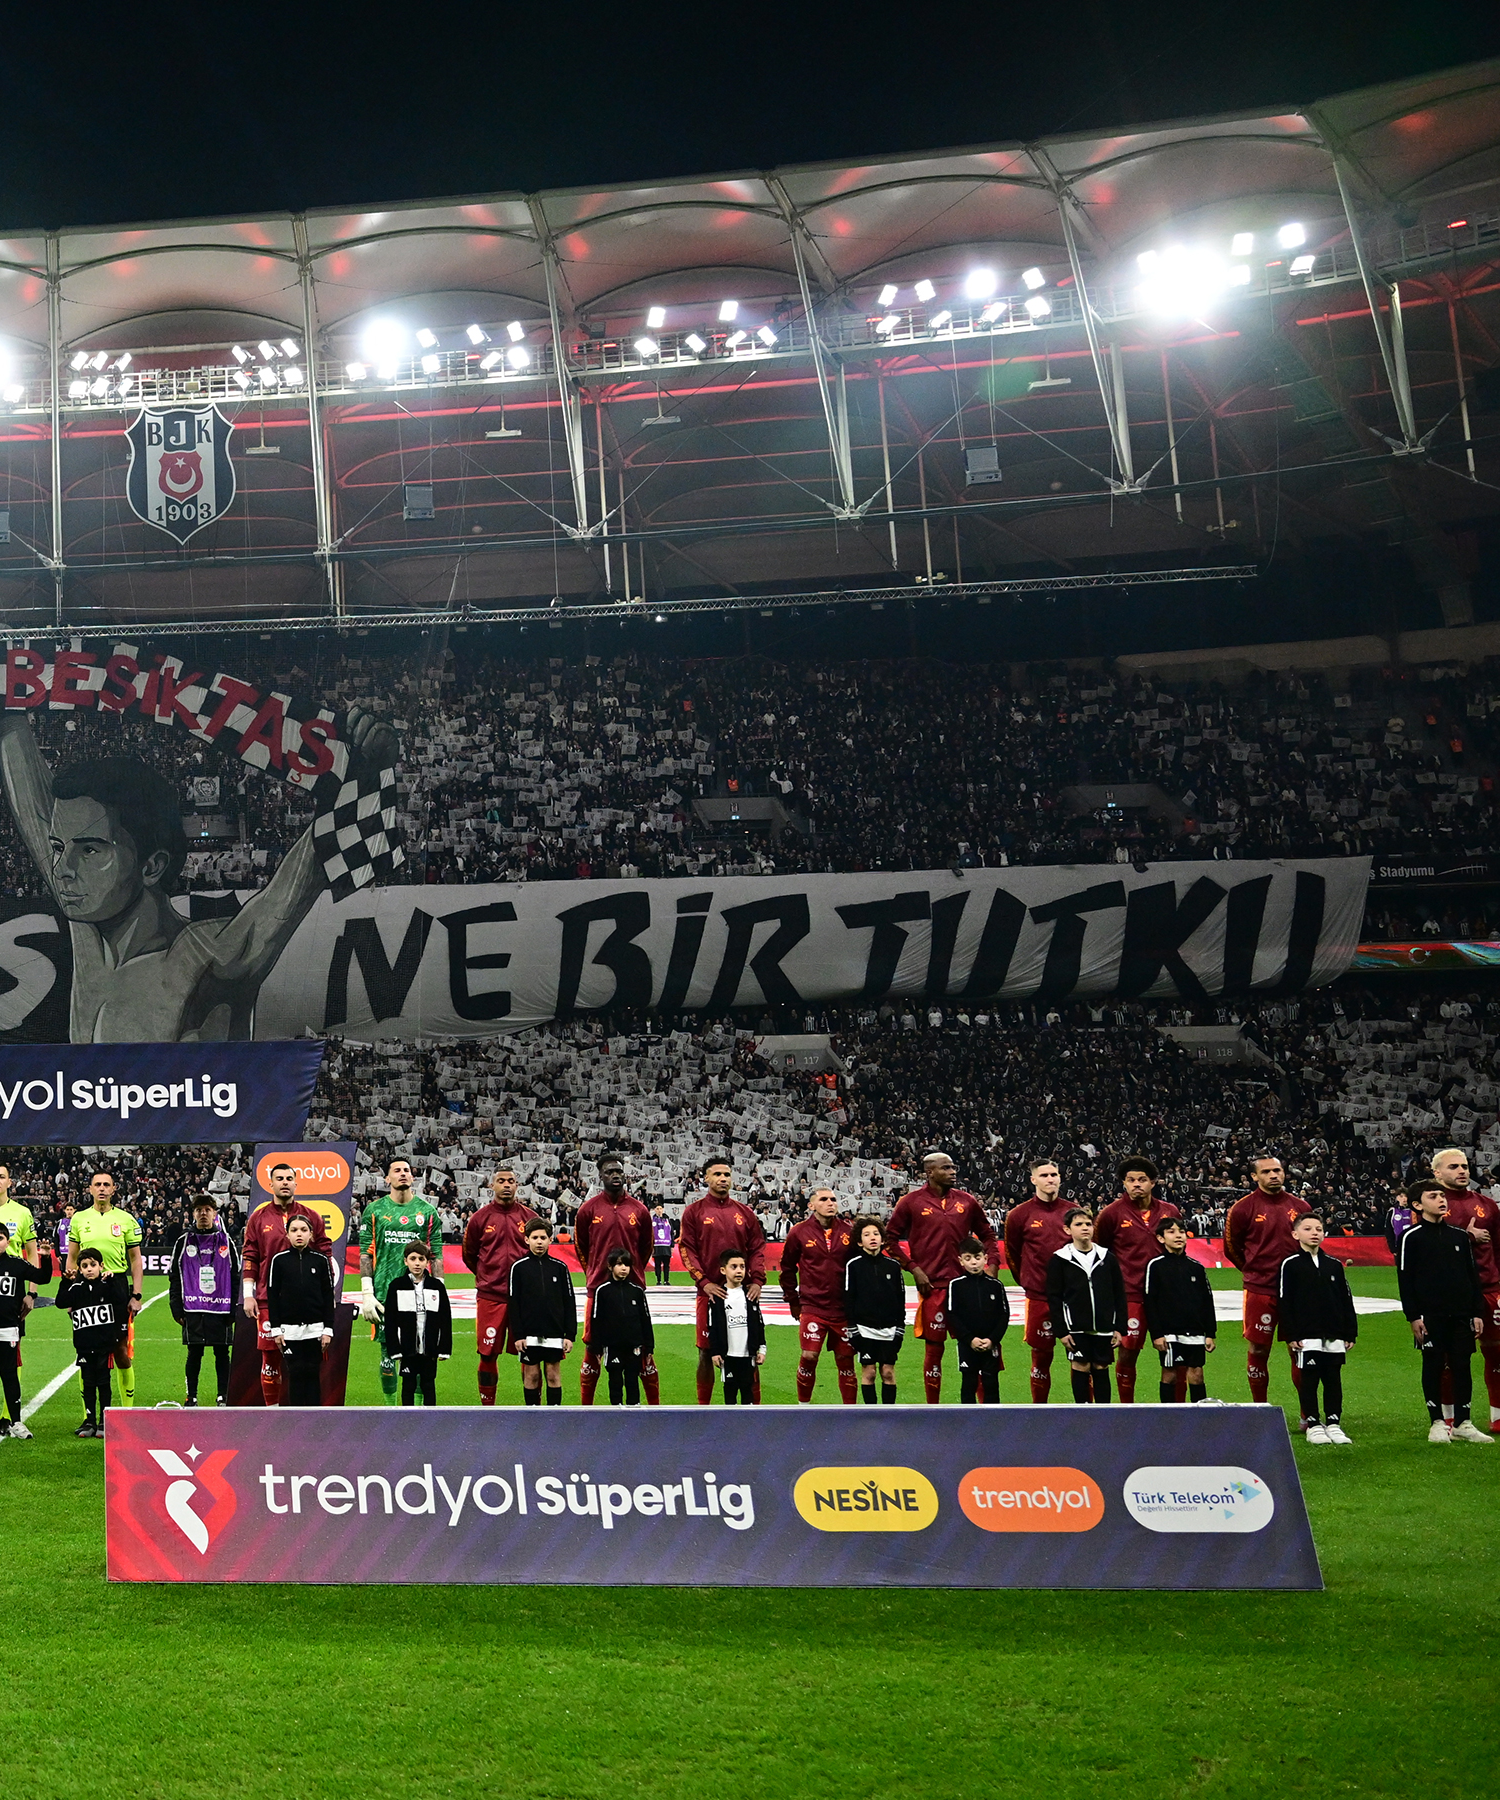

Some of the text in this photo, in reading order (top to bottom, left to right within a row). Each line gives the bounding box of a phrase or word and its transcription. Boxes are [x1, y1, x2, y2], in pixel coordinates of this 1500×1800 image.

[155, 503, 212, 521] 1903
[1379, 865, 1435, 879] Stadyumu
[323, 901, 519, 1027] NE
[838, 871, 1326, 1000] TUTKU
[803, 1056, 820, 1065] 117
[1217, 1048, 1233, 1057] 118
[72, 1074, 238, 1119] SüperLig
[266, 1164, 341, 1182] tndyol
[141, 1255, 172, 1274] BEŞ
[198, 1296, 231, 1304] TOPLAYICI
[72, 1304, 114, 1330] SAYGI
[257, 1463, 755, 1531] trendyol SüperLig
[971, 1485, 1091, 1513] trendyol
[1132, 1491, 1236, 1504] Türk Telekom
